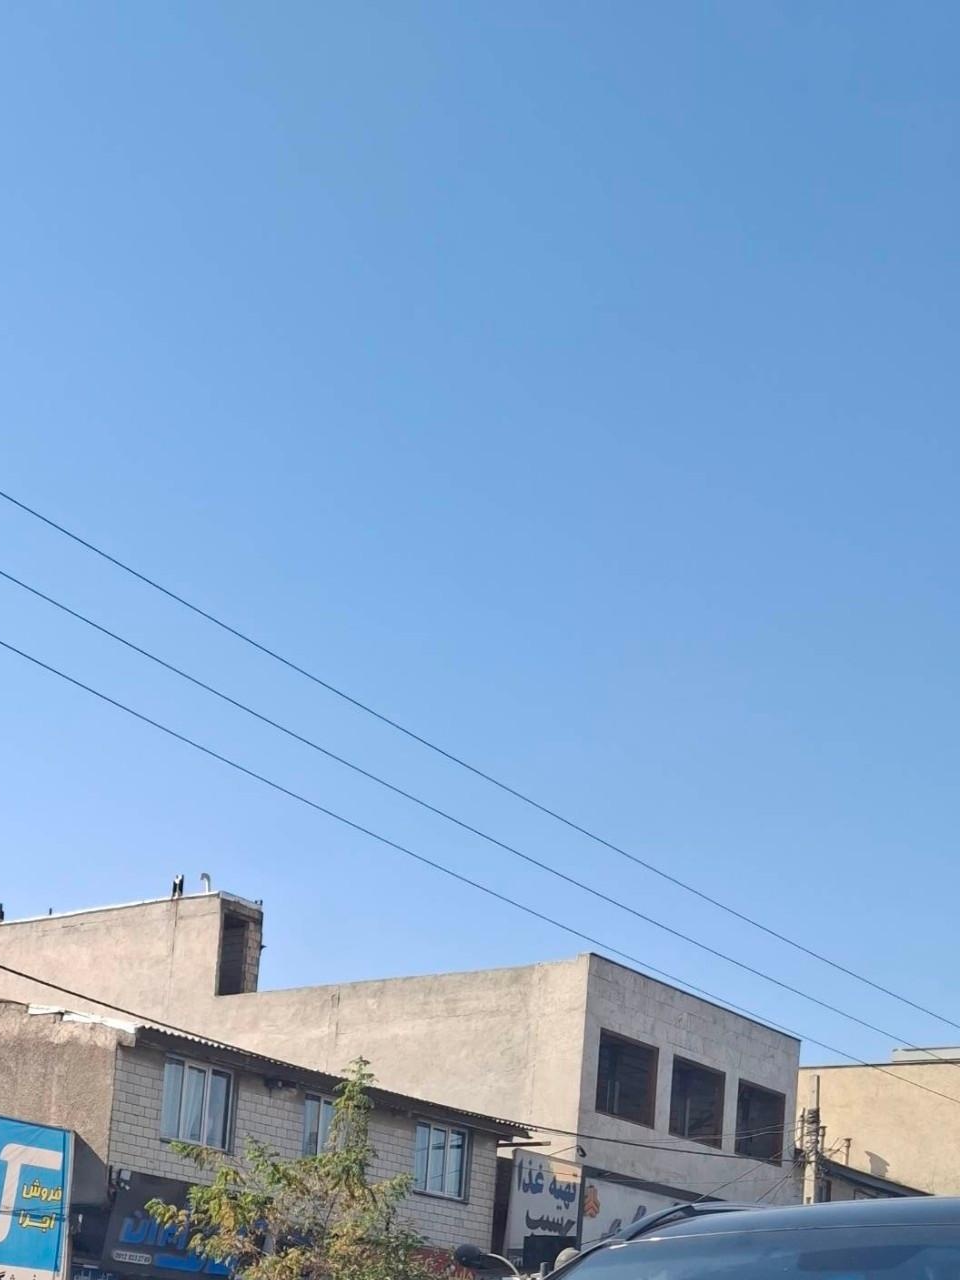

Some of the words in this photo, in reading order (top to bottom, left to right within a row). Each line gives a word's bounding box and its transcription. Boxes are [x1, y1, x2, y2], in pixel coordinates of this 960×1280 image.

[517, 1158, 545, 1195] غذا
[22, 1179, 62, 1201] فروش
[18, 1210, 56, 1232] اجرا
